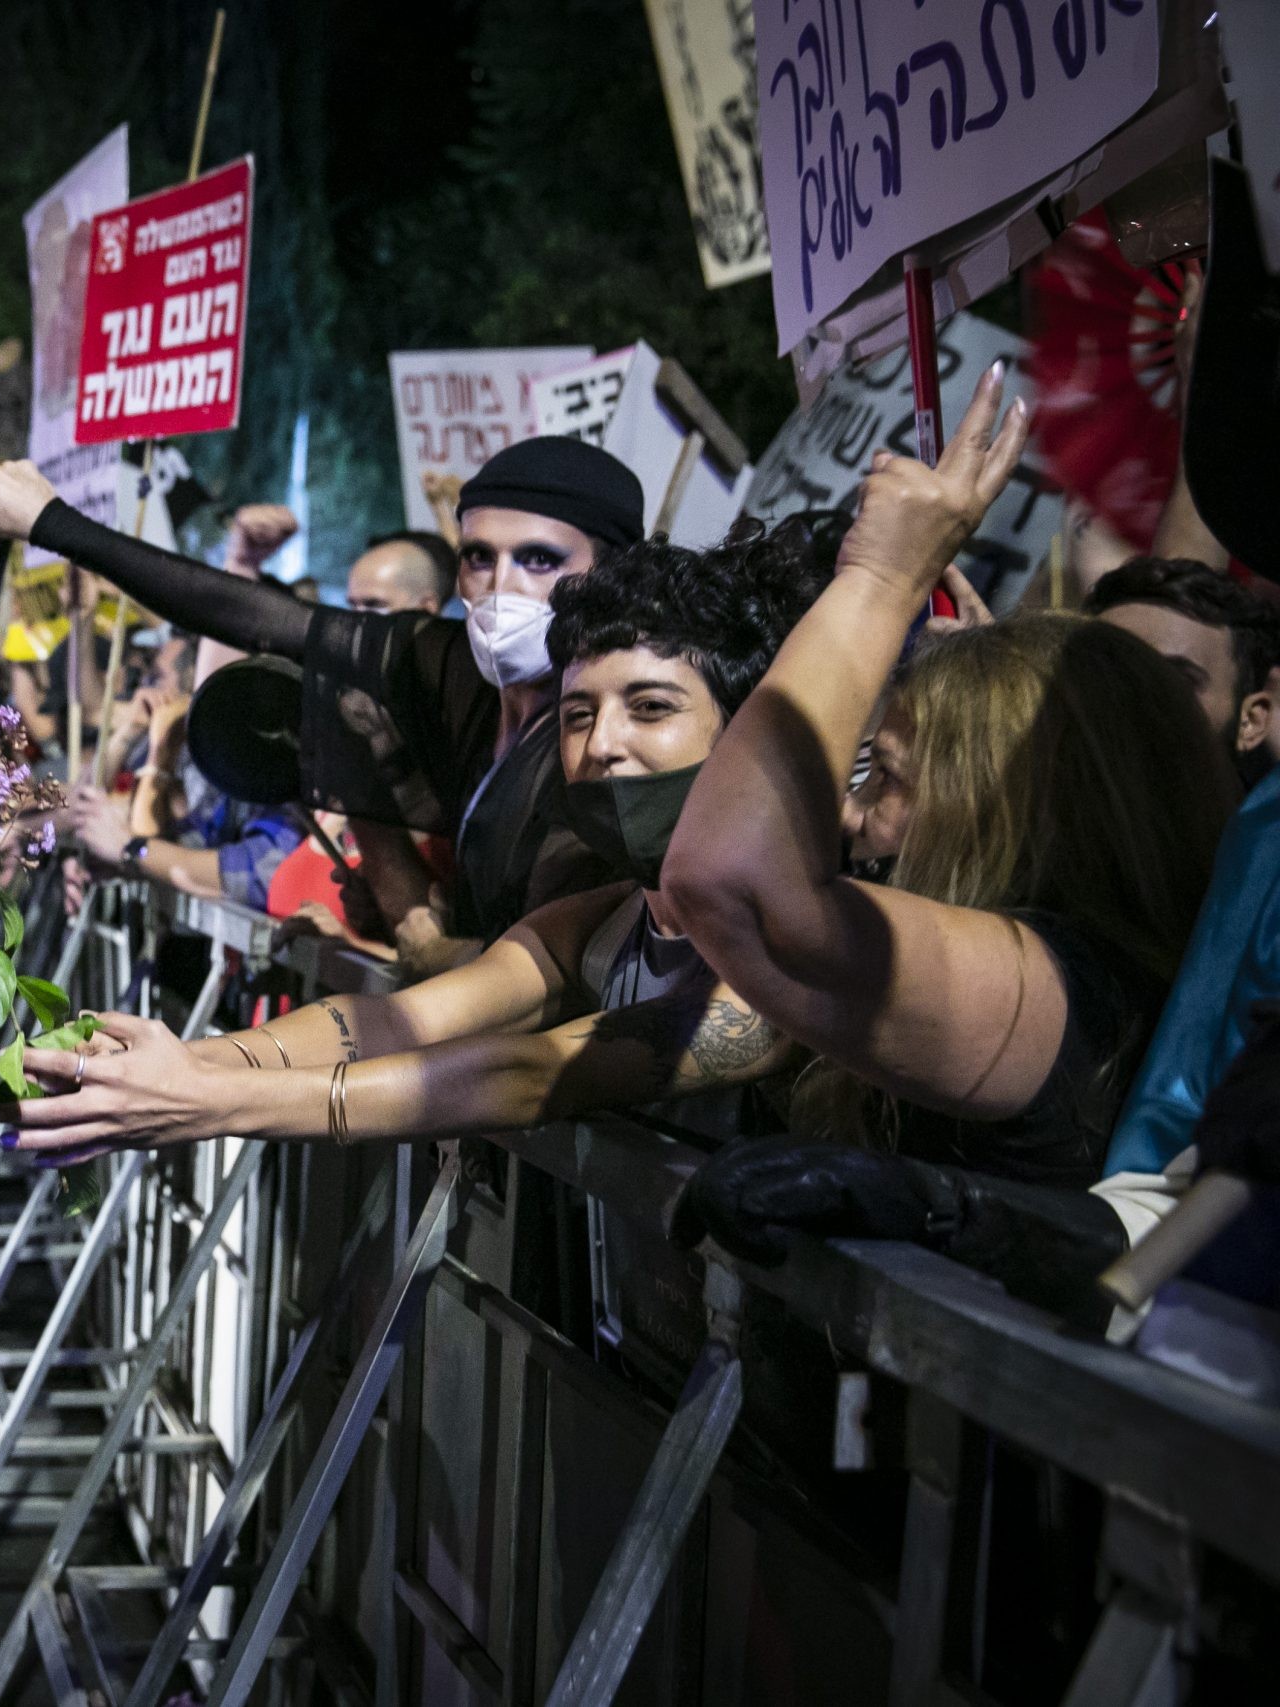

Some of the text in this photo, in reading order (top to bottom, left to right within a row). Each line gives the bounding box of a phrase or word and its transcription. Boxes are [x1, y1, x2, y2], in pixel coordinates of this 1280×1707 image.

[164, 234, 242, 287] נגד העם
[101, 281, 239, 358] העם נגד
[81, 349, 234, 422] הממשלה
